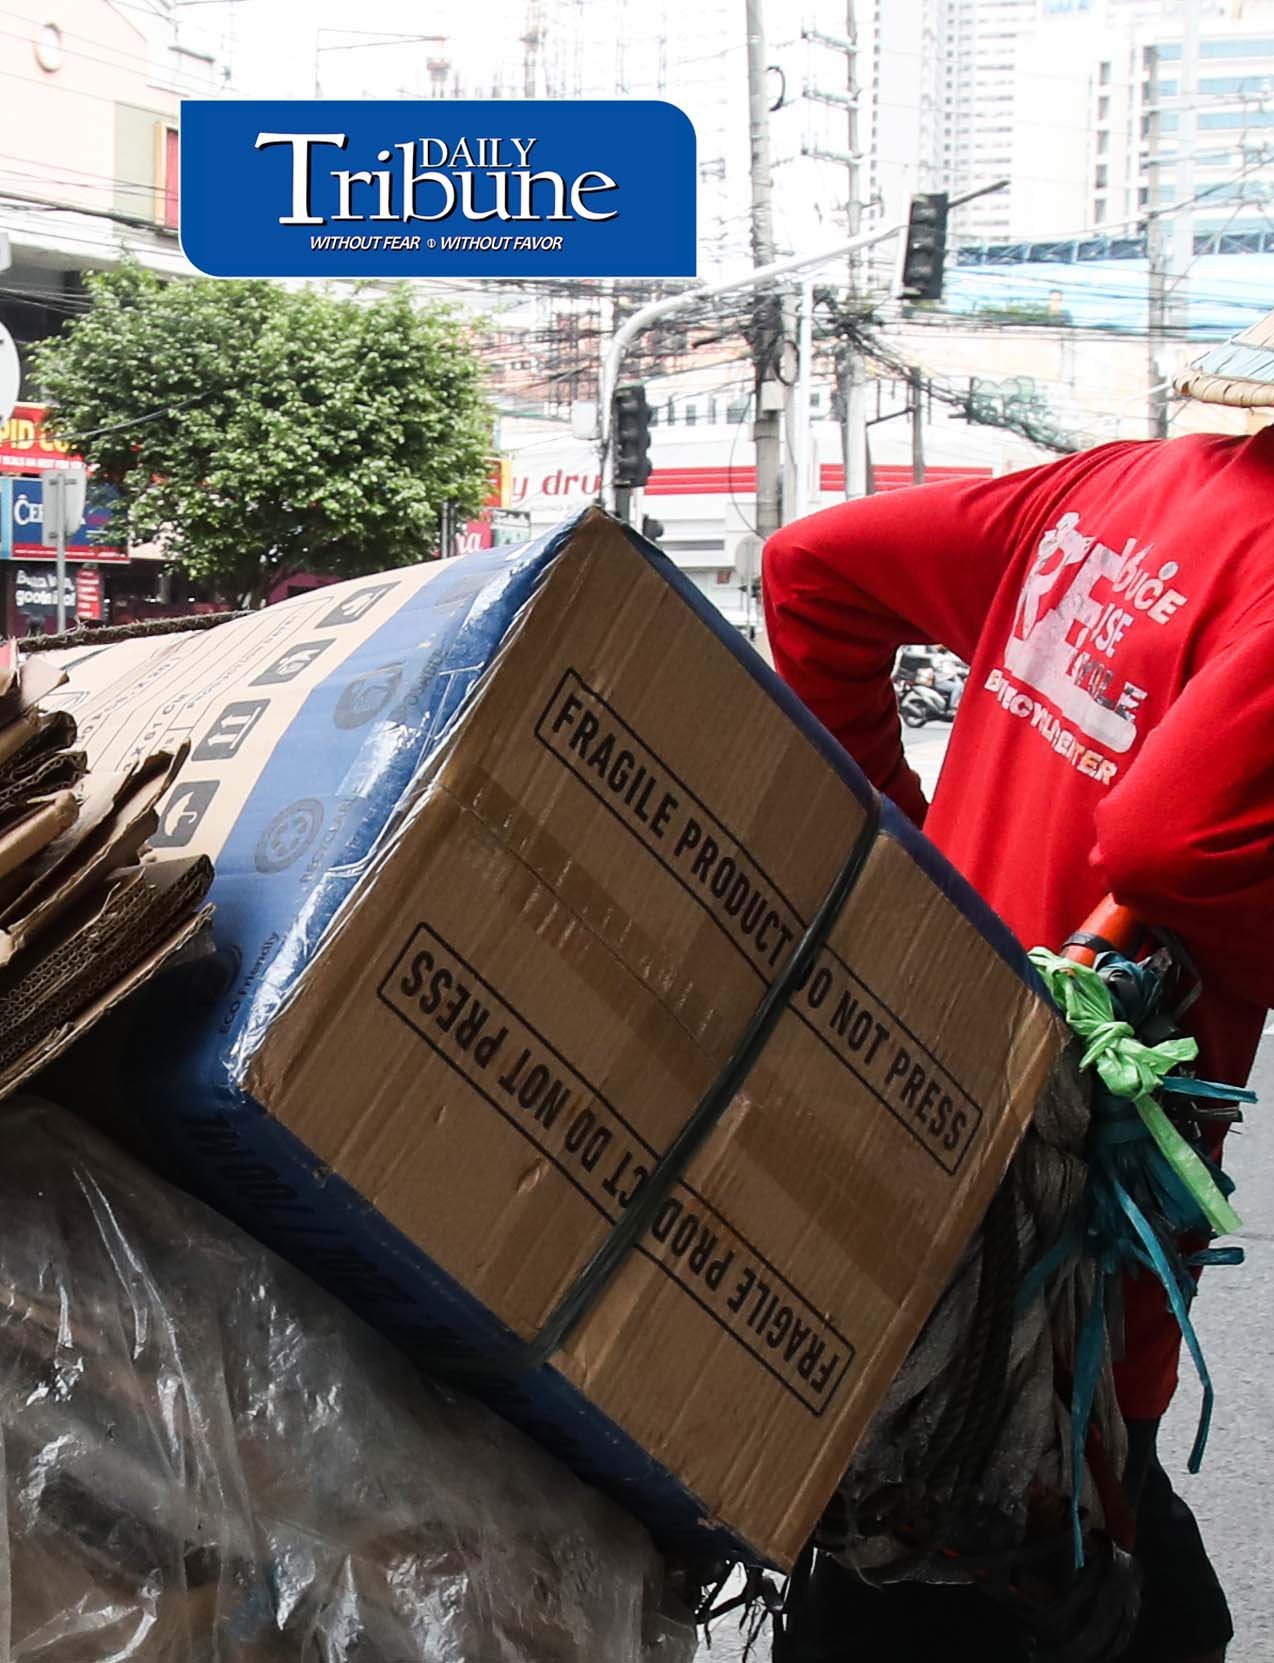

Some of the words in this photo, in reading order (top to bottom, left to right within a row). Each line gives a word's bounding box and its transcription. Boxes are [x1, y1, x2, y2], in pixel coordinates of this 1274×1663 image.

[541, 469, 603, 497] dru
[551, 698, 680, 839] FRAGILE
[673, 821, 794, 969] PRODUCT
[830, 987, 890, 1065] NOT
[885, 1052, 970, 1153] PRESS
[400, 950, 510, 1069] PRESS
[497, 1048, 572, 1130] NOT
[564, 1112, 613, 1173] DO
[603, 1151, 736, 1292] PRODCT
[727, 1267, 840, 1393] FRAGILE
